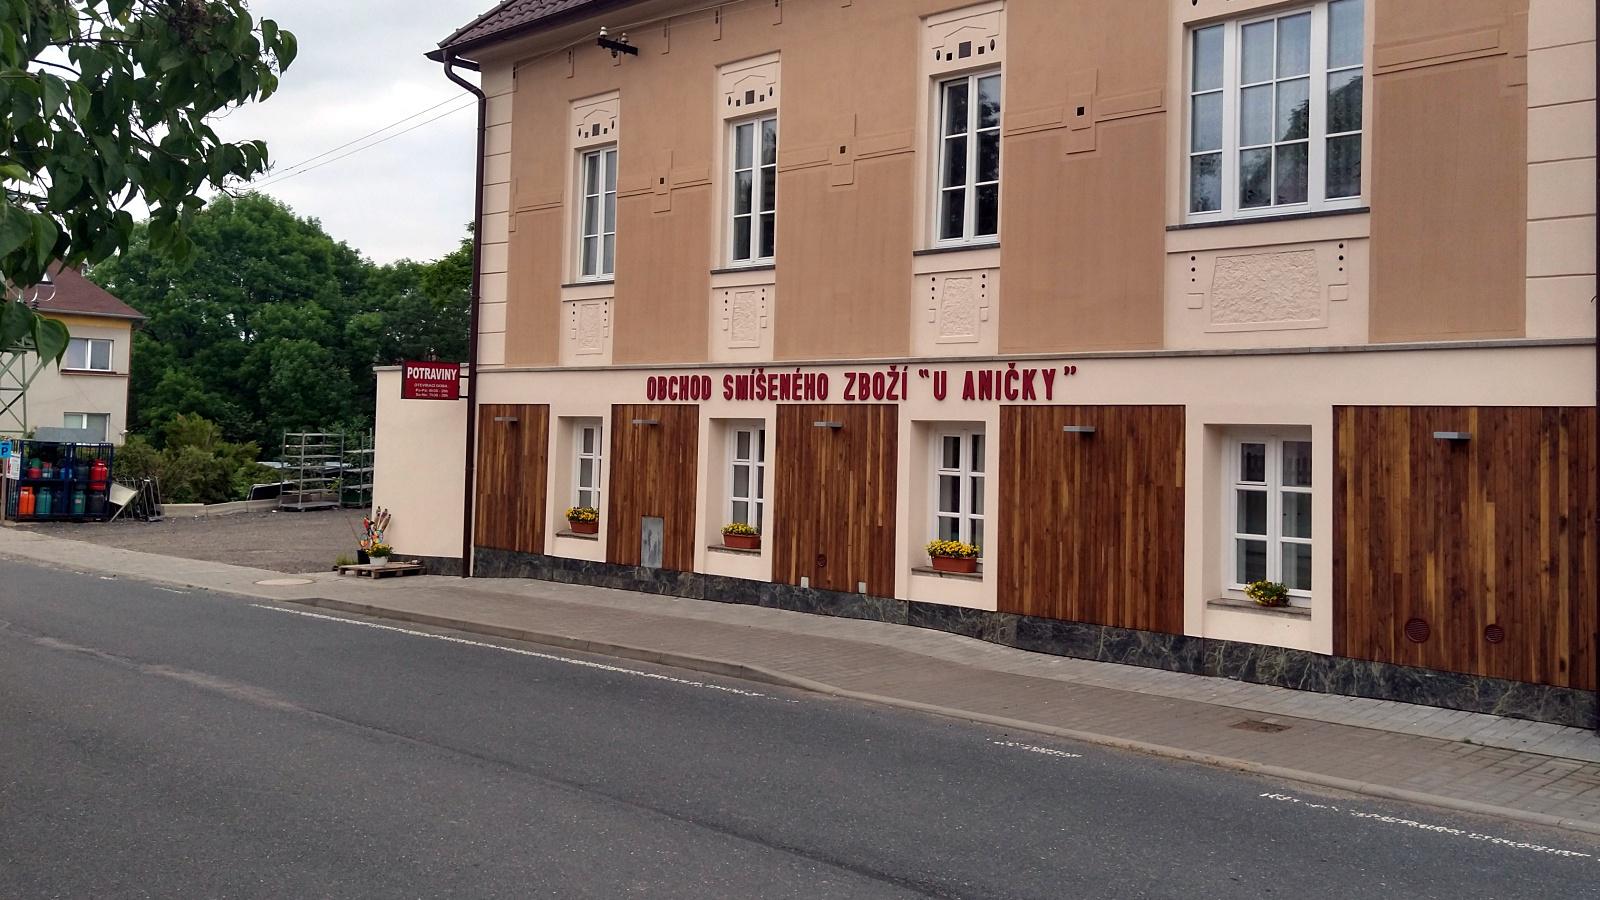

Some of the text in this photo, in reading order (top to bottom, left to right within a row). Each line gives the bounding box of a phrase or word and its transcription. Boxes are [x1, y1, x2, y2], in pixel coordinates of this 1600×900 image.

[407, 367, 457, 381] POTRAVINY
[647, 375, 712, 401] OBCHOD
[723, 367, 829, 401] SMÍŠENÉHO
[843, 366, 909, 401] ZBOŽÍ
[1, 447, 8, 456] P
